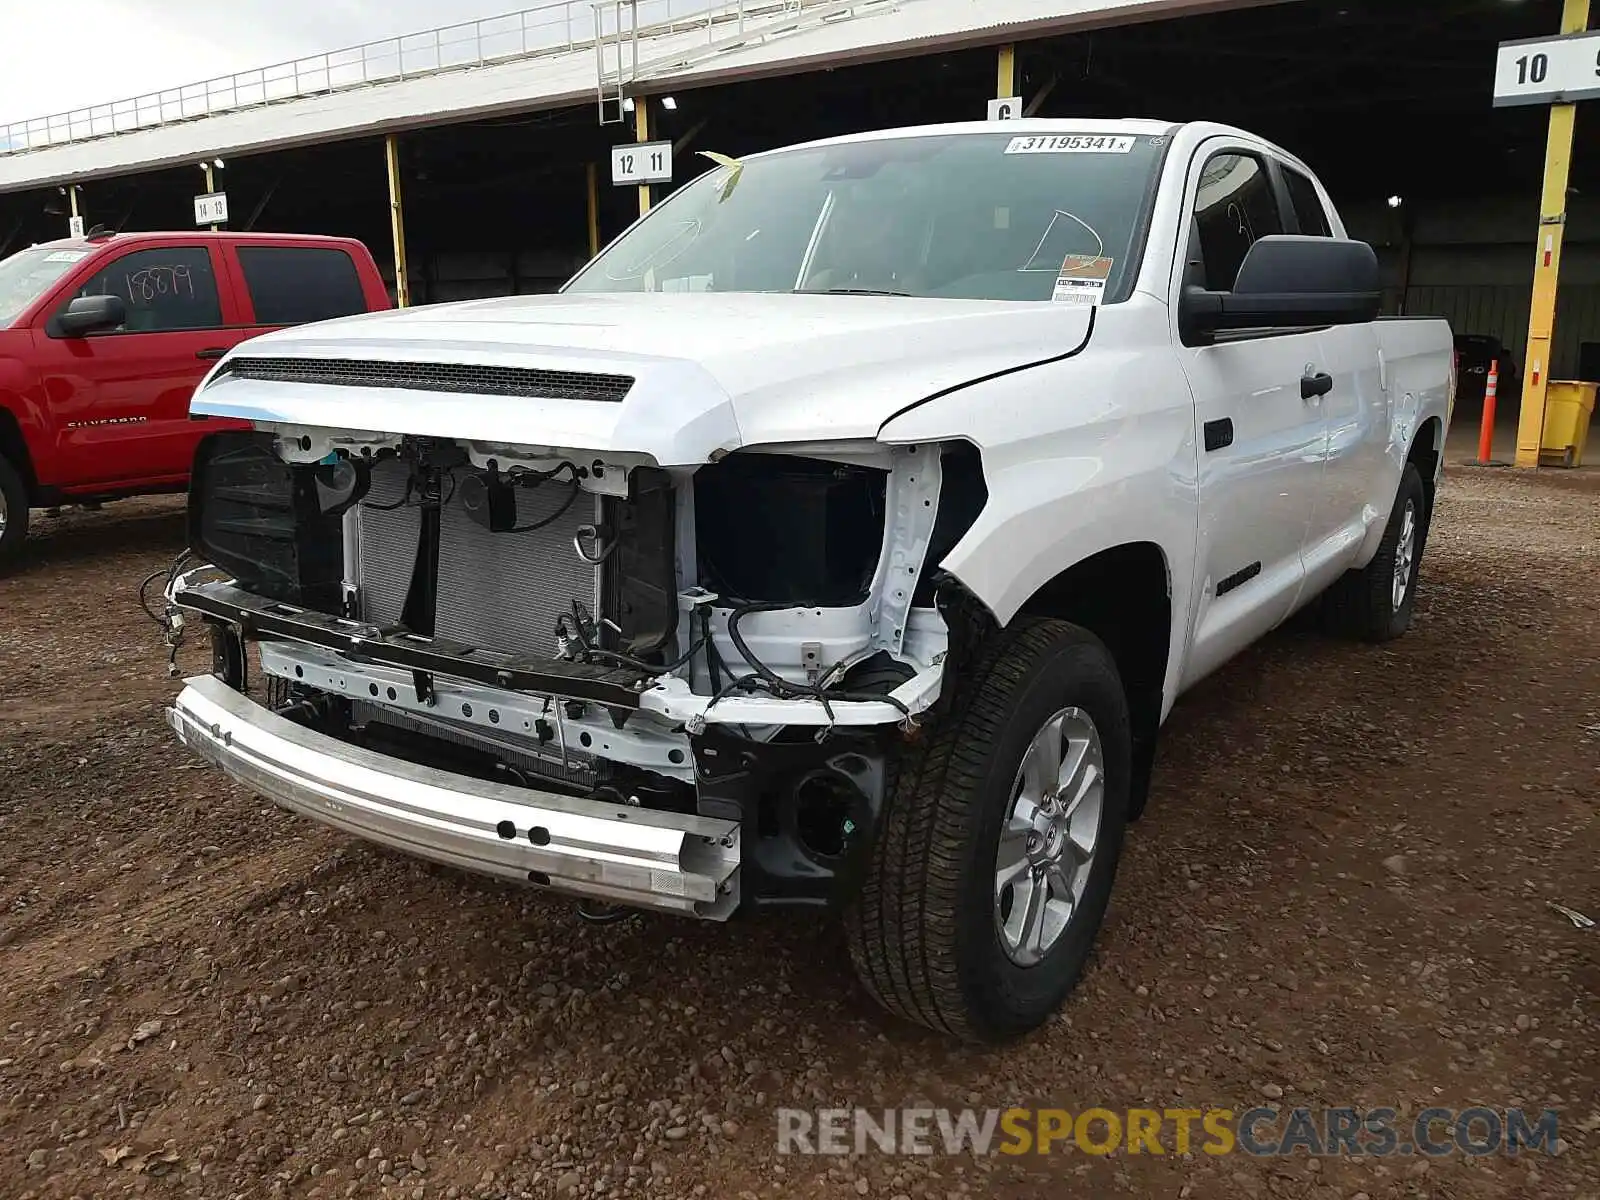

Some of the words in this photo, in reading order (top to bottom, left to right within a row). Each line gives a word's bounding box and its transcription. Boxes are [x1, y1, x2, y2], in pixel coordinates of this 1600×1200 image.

[1516, 53, 1548, 84] 10
[620, 155, 633, 174] 12
[651, 152, 662, 171] 11
